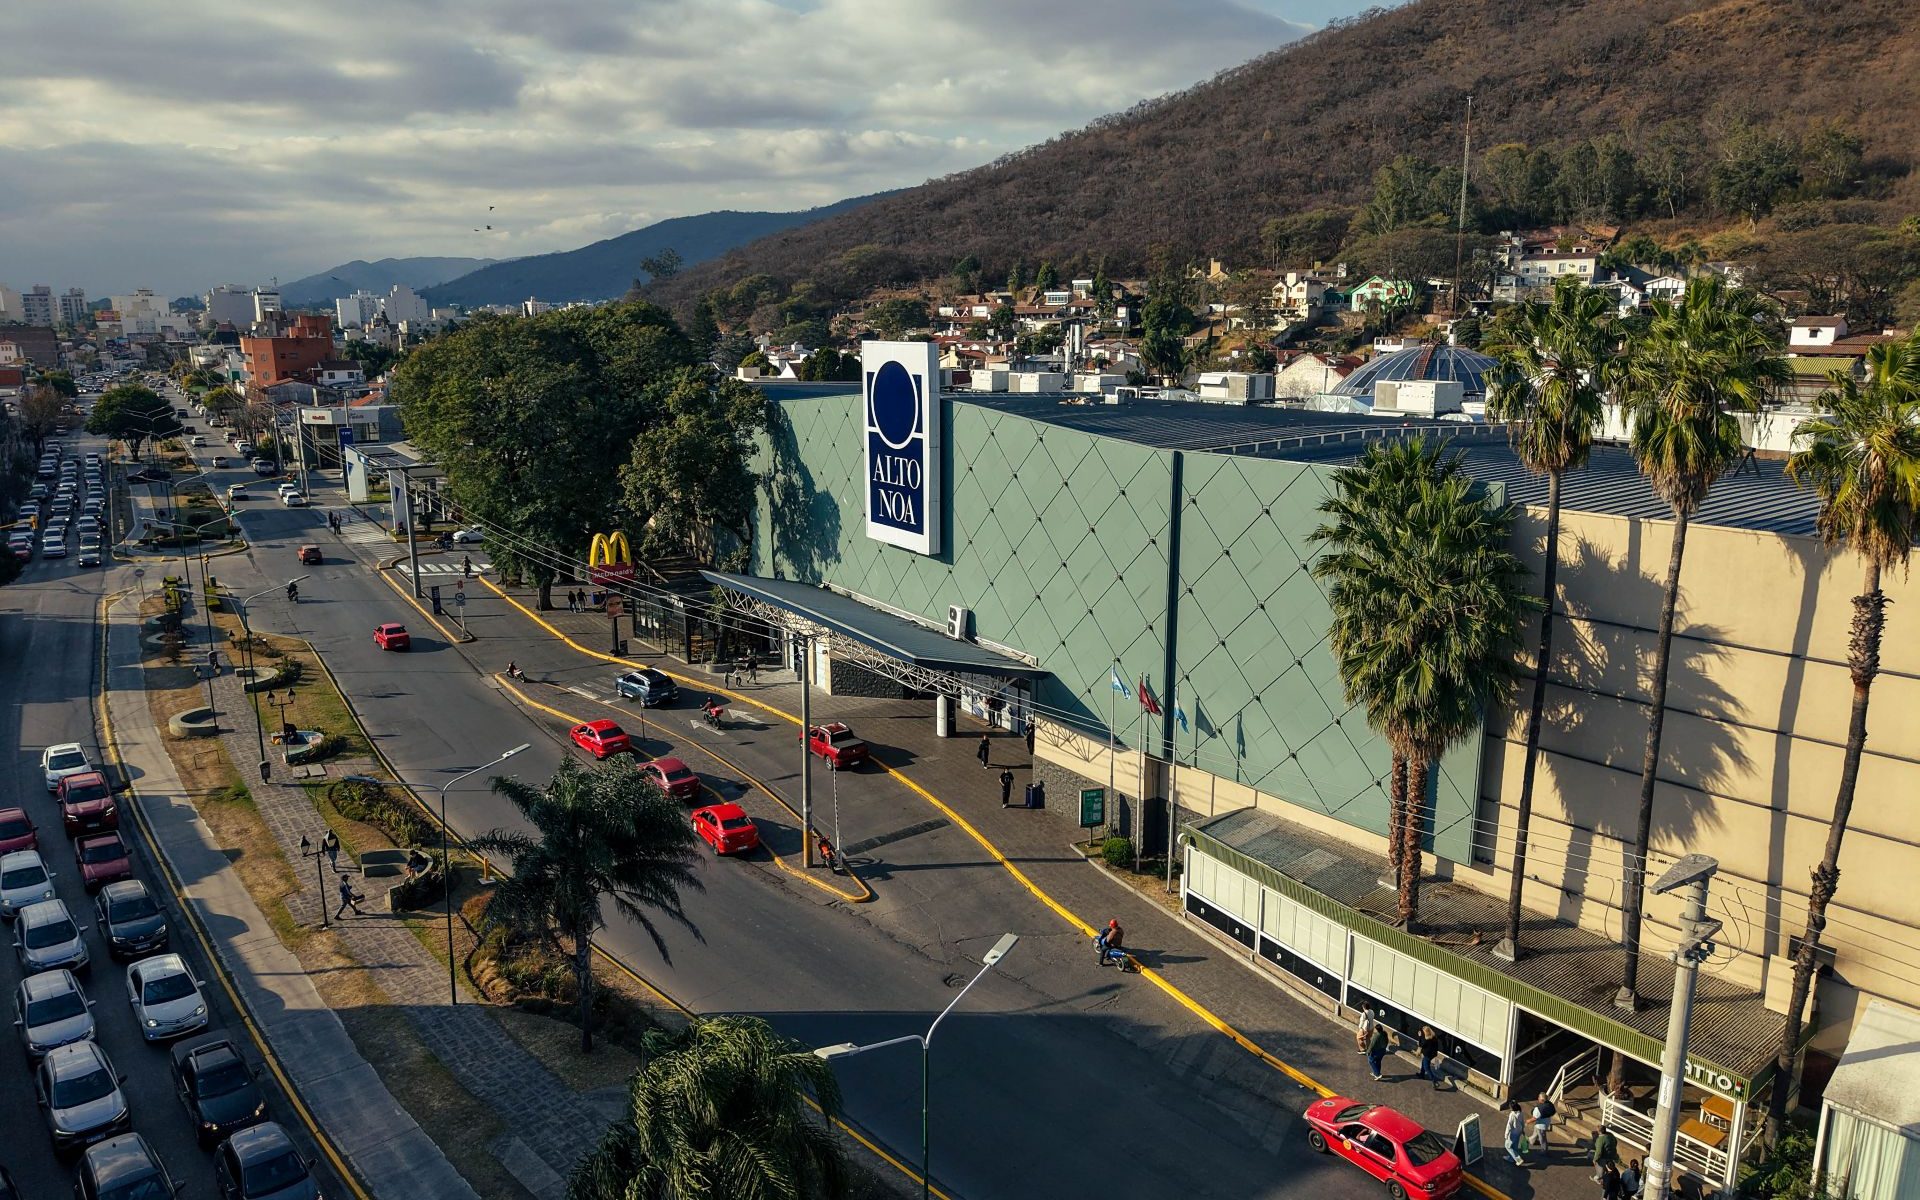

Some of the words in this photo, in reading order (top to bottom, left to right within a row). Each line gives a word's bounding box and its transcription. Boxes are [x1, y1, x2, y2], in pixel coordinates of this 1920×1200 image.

[872, 453, 921, 490] ALTO
[878, 488, 917, 525] NOA
[594, 569, 634, 578] McDonald's
